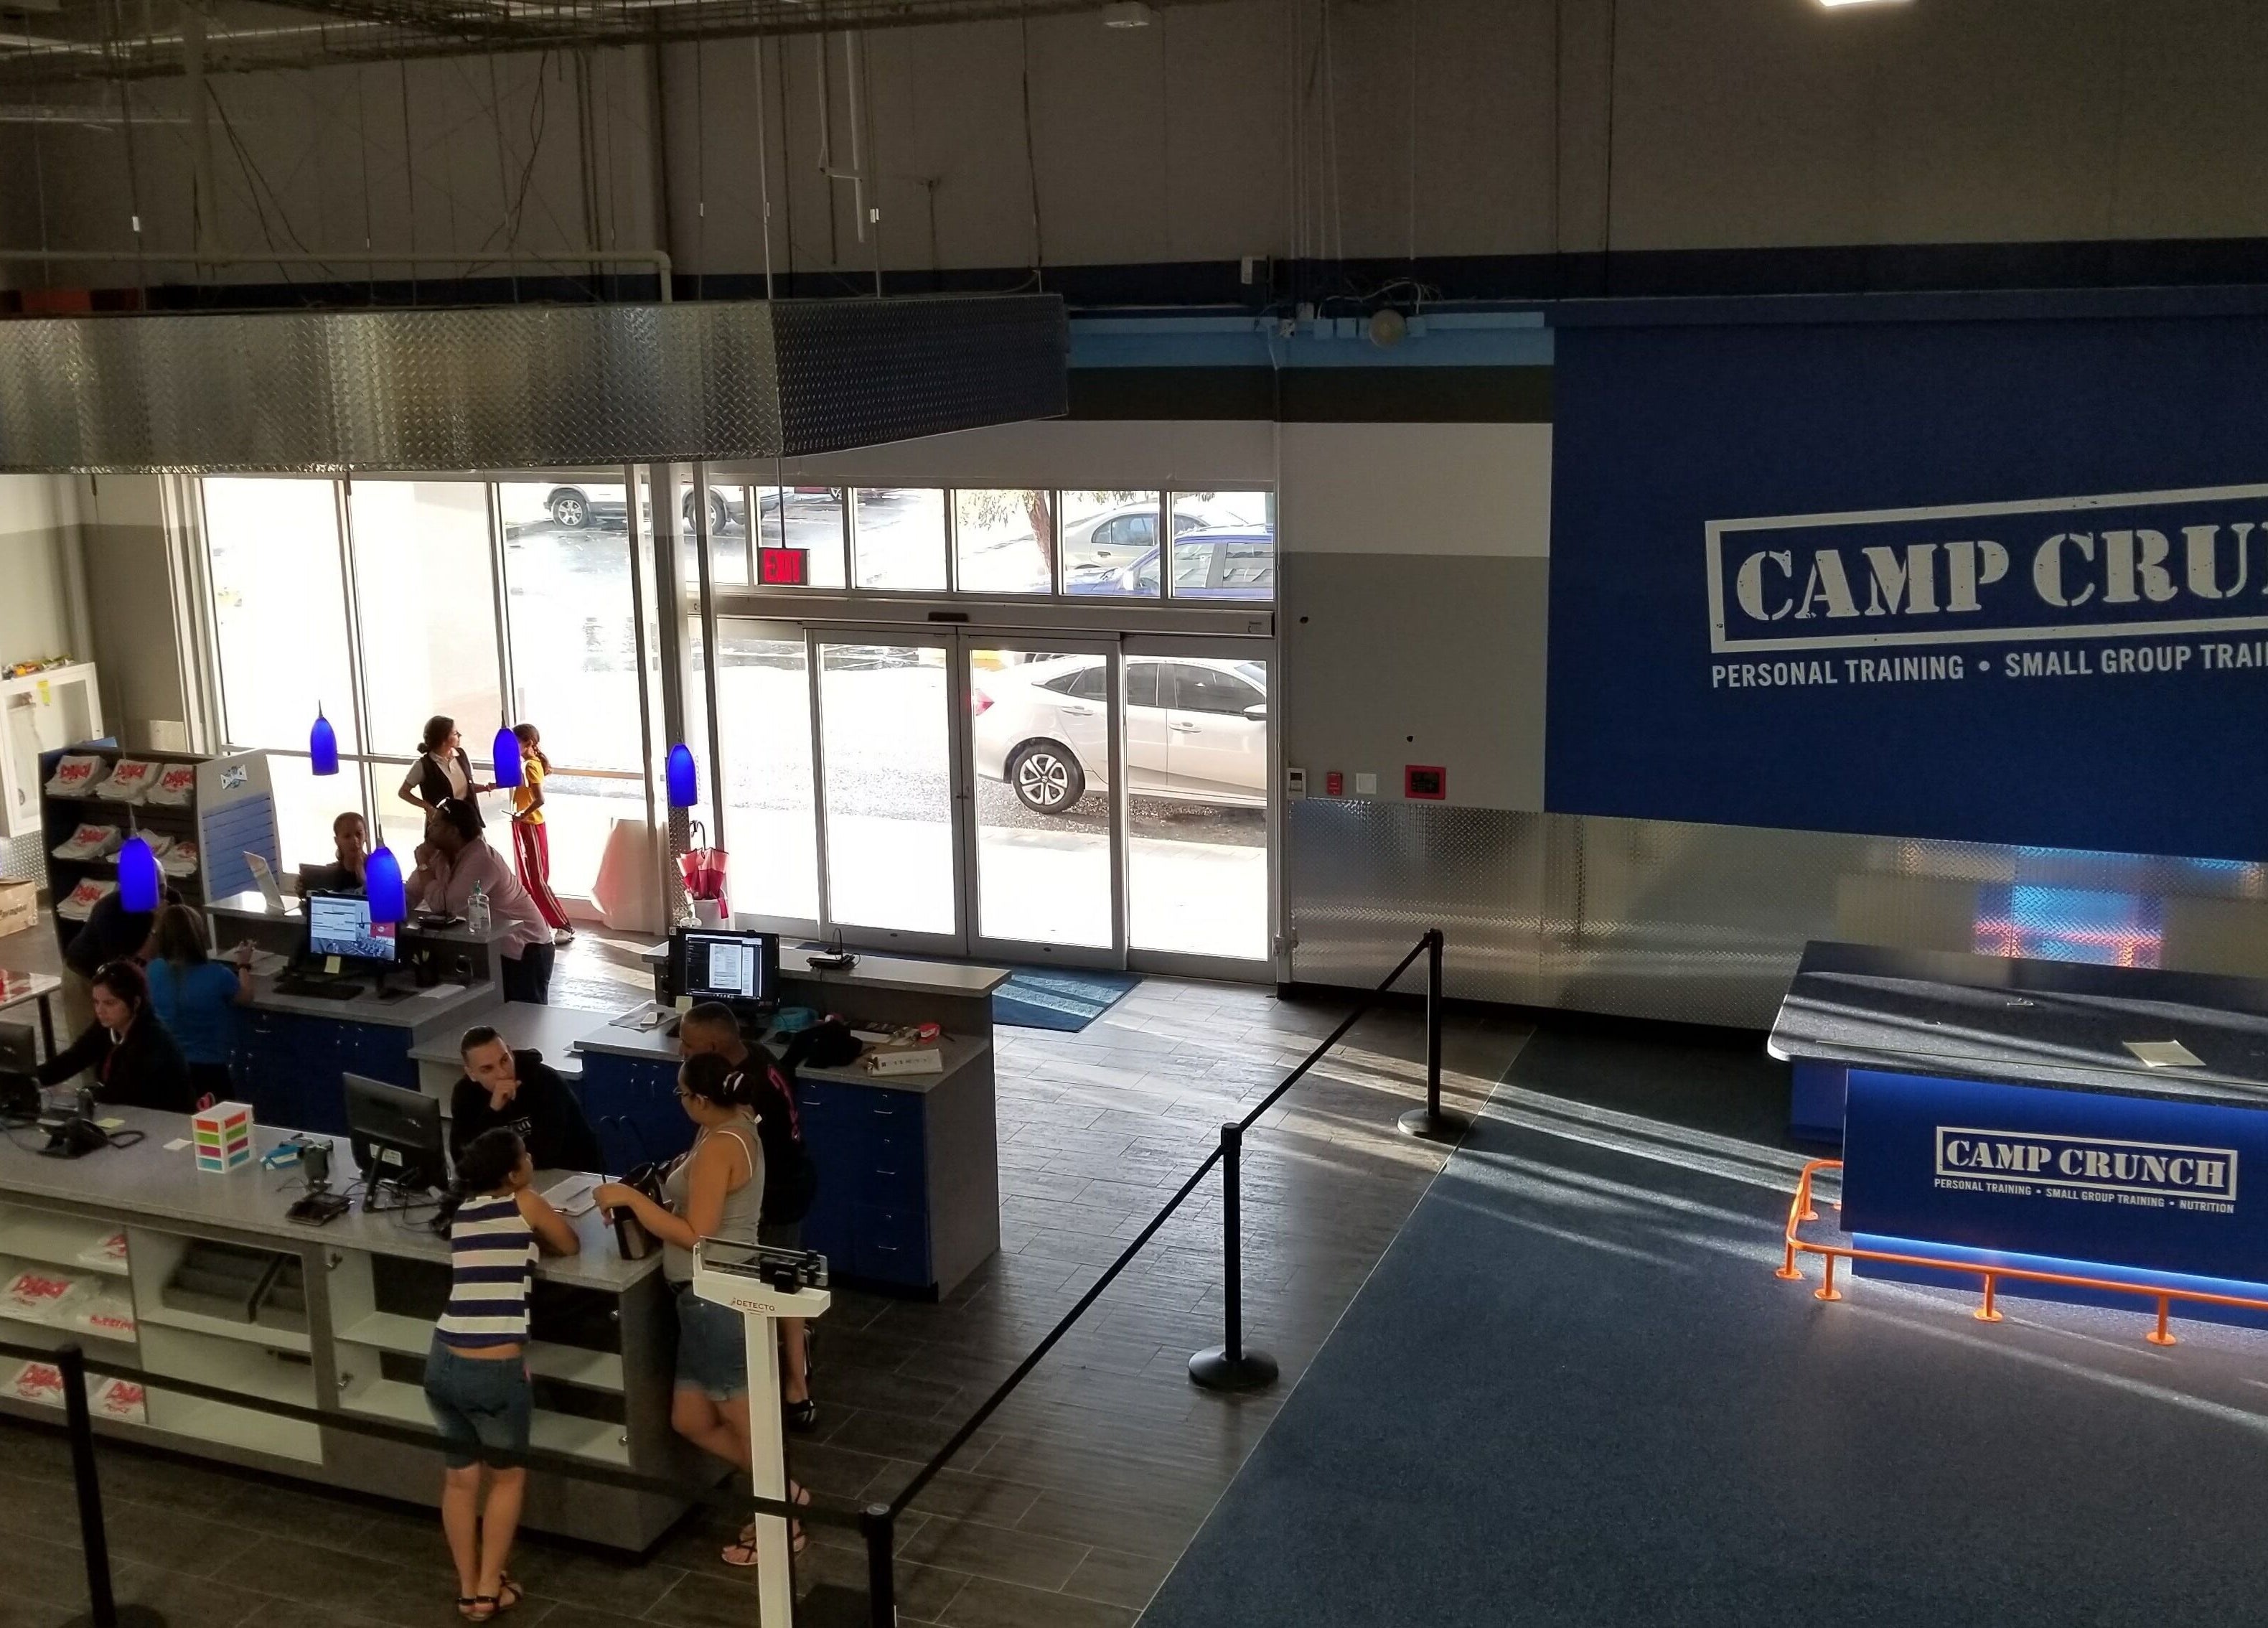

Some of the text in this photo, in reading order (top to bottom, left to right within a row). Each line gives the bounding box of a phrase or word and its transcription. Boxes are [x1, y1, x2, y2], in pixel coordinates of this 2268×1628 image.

[1736, 521, 2268, 621] CAMP CRU
[1712, 660, 1838, 688] PERSONAL
[1844, 655, 1964, 683] TRAINING
[2005, 650, 2093, 678] SMALL
[2101, 645, 2192, 674] GROUP
[1946, 1140, 2226, 1188] CAMP CRUNCH
[1934, 1178, 2235, 1214] PERSONAL TRAINING SMALL GROUP TRAINING NUTRITION
[736, 1299, 775, 1311] DETECTO
